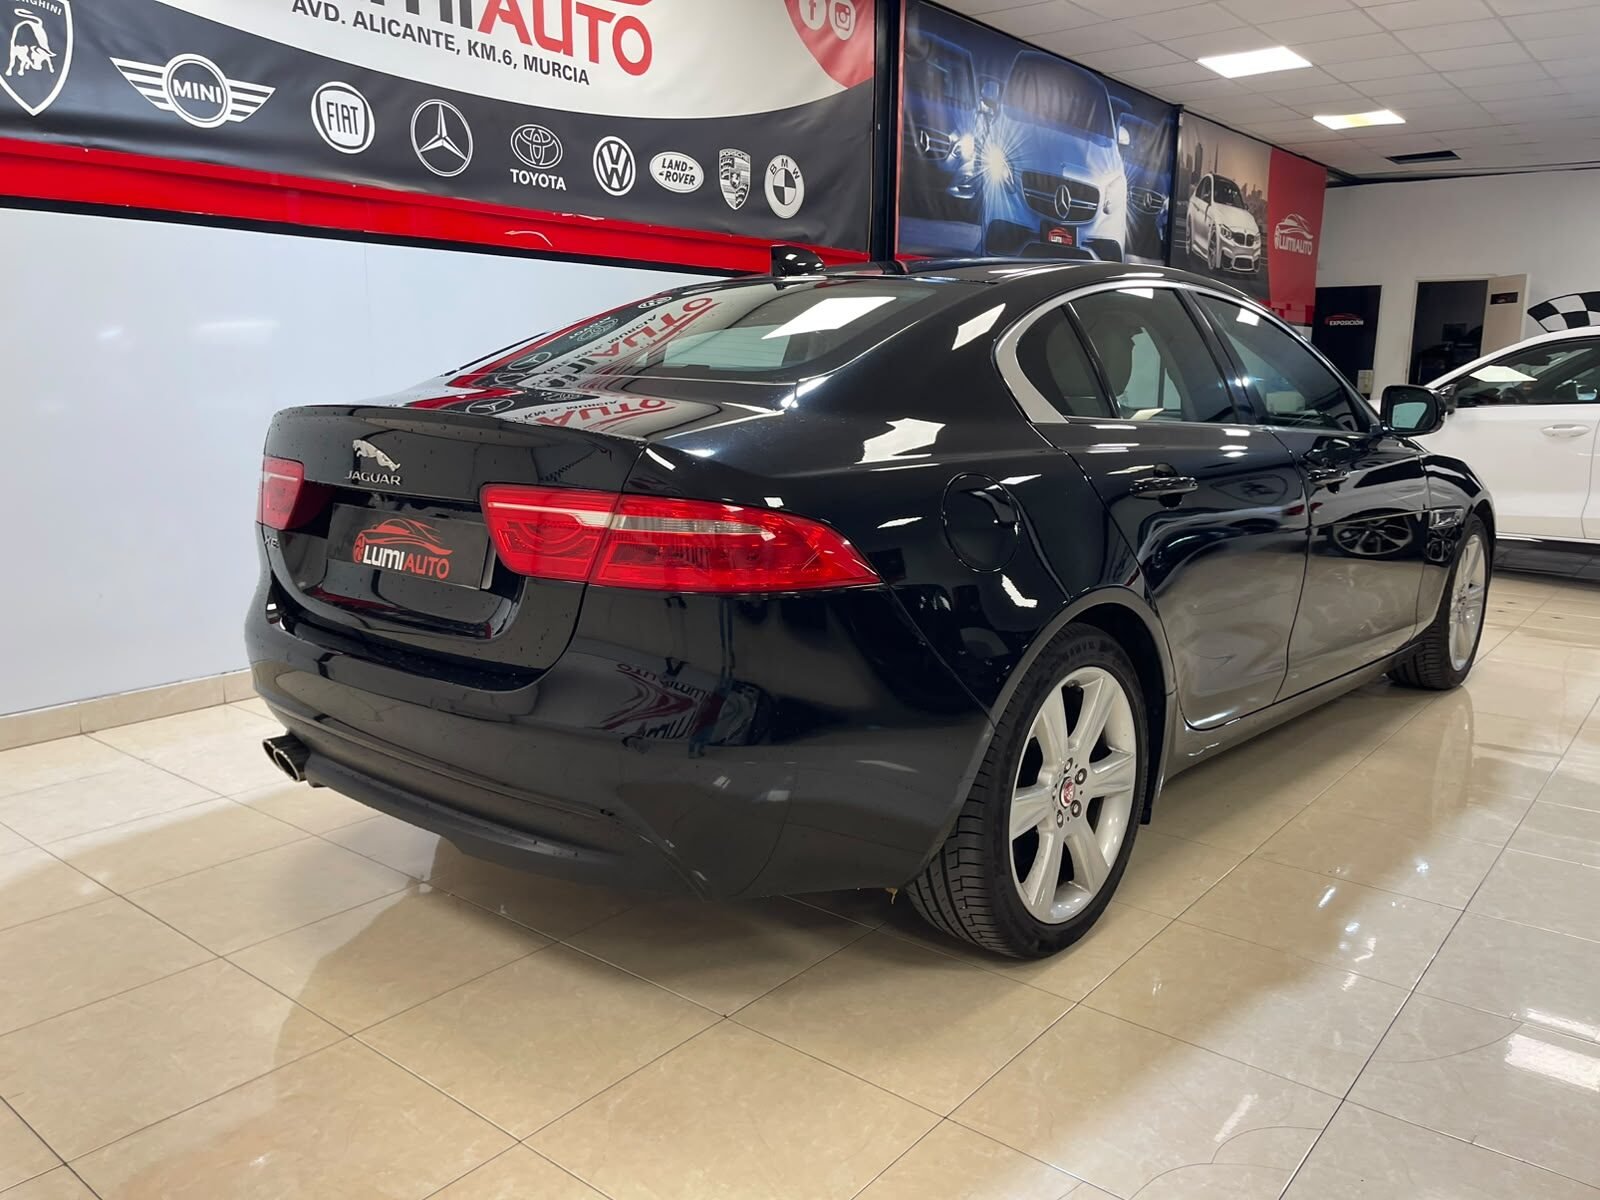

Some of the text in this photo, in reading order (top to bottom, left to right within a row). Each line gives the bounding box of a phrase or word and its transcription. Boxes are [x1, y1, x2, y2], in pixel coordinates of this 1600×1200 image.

[291, 0, 590, 86] AVD. ALICANTE, KM.6, MURCIA
[173, 78, 223, 104] MINI
[326, 101, 360, 136] FIAT
[661, 157, 688, 173] LAND
[769, 158, 801, 180] BMW
[509, 167, 567, 192] TOYOTA
[664, 171, 696, 187] ROVER
[345, 470, 401, 486] JAGUAR
[362, 544, 450, 580] LUMIAUTO
